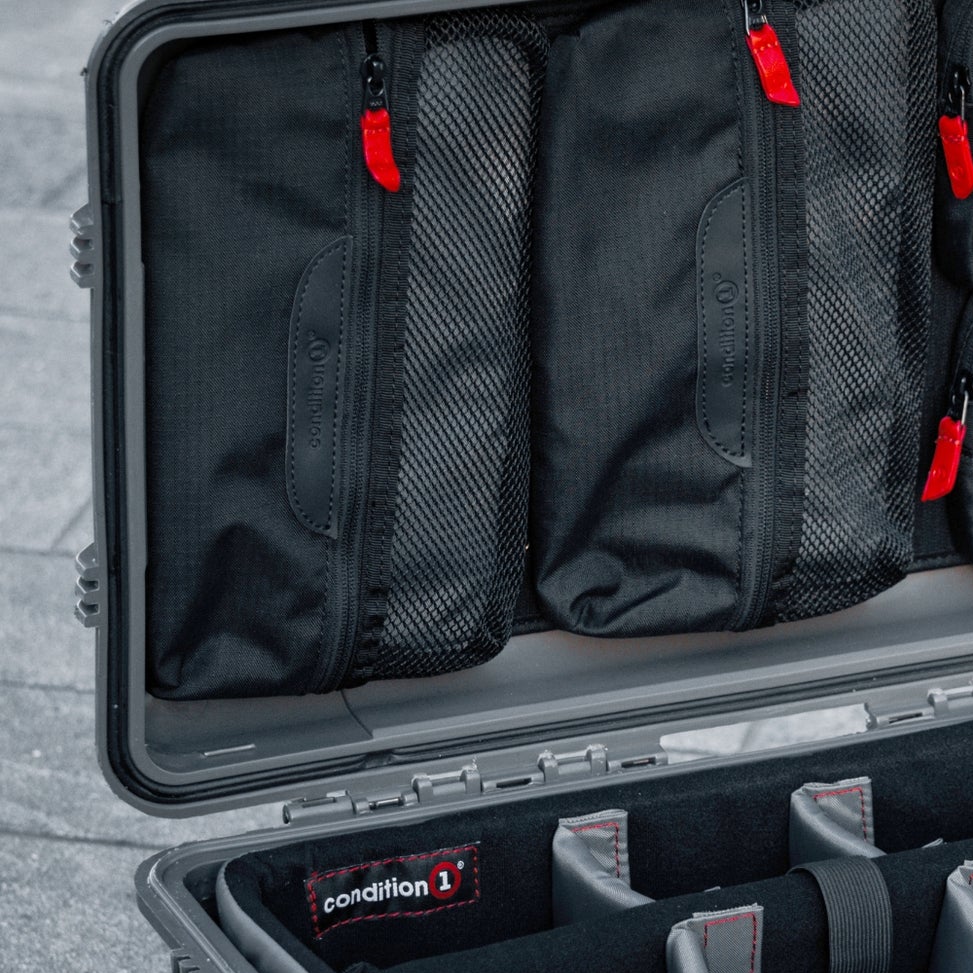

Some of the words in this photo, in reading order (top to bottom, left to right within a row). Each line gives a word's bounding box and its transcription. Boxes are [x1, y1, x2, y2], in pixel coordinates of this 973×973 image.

[719, 306, 736, 387] condition
[307, 365, 325, 449] condition
[324, 877, 428, 913] condition
